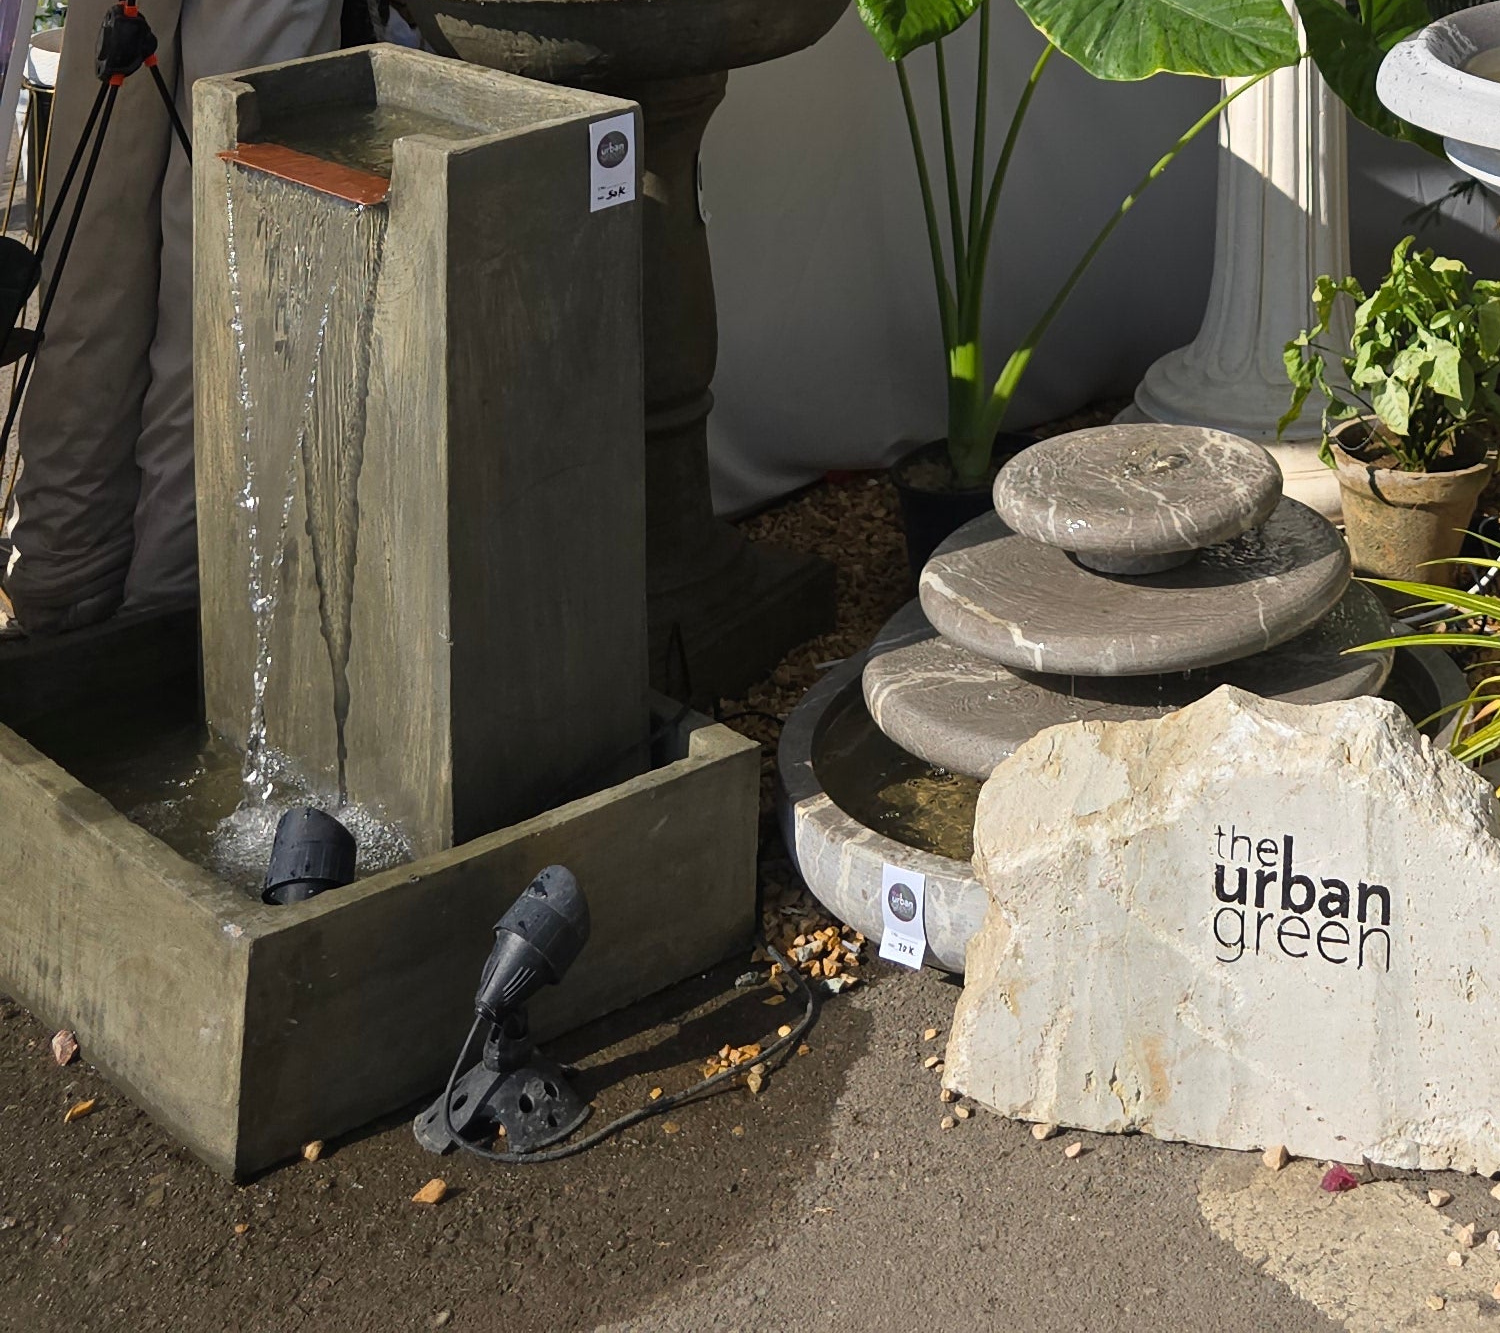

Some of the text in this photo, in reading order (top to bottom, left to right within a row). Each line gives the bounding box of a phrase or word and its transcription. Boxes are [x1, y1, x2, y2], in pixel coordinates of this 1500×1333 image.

[1214, 825, 1279, 867] the
[891, 892, 914, 908] urban
[1215, 834, 1391, 926] urban
[1213, 907, 1391, 973] green
